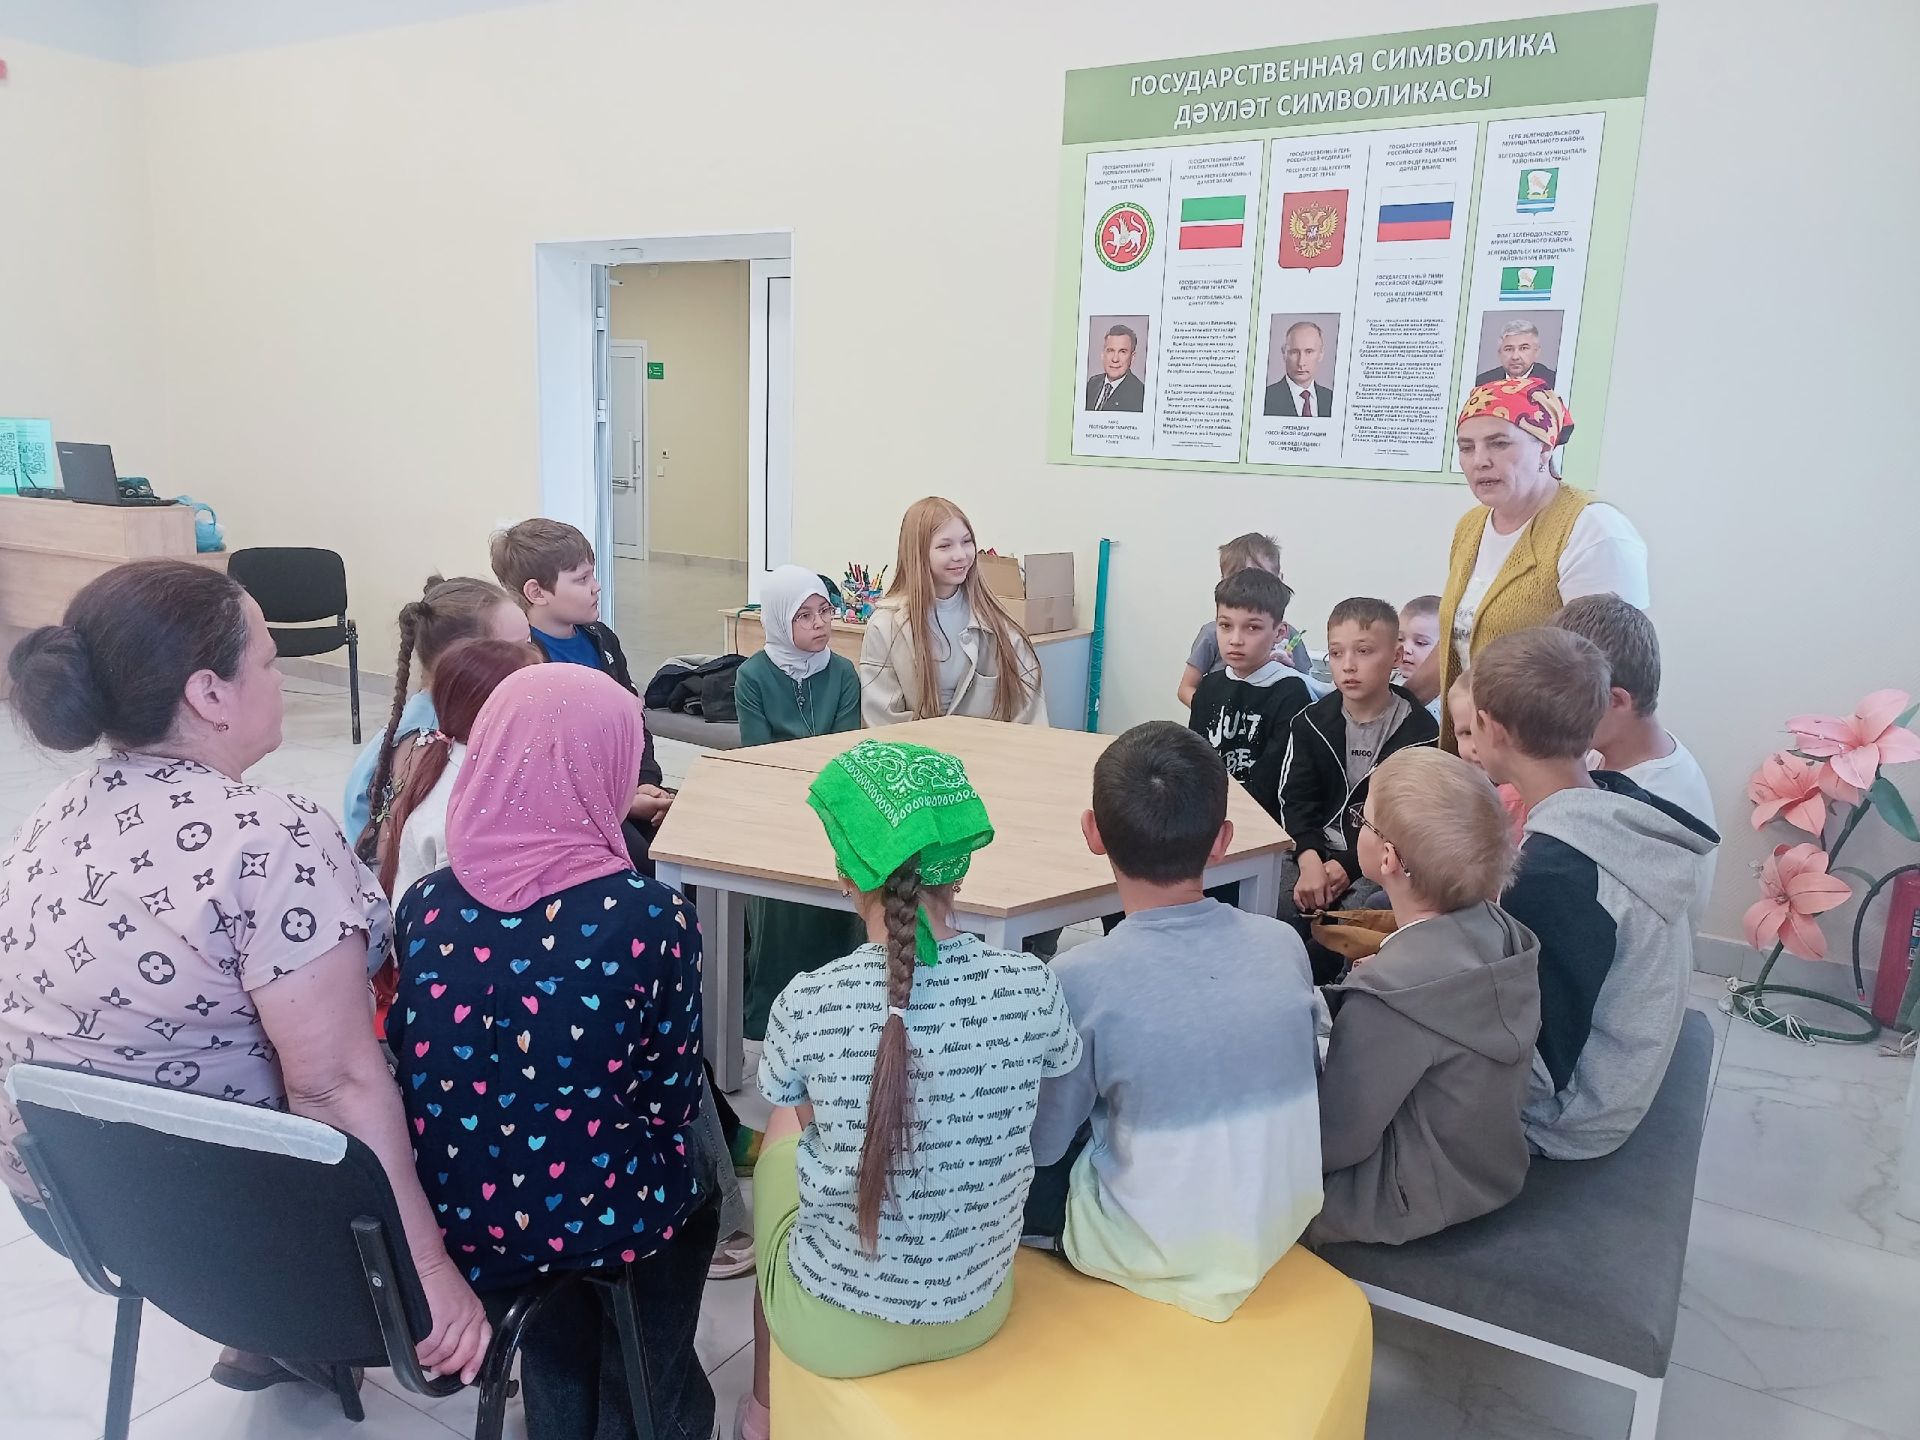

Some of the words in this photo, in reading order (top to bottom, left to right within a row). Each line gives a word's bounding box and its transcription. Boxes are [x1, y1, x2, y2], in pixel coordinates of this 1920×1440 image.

[1130, 53, 1364, 97] ГОСУДАРСТВЕННАЯ
[1371, 31, 1556, 71] СИМВОЛИКА
[1174, 97, 1270, 129] ДӘҮЛӘТ
[1276, 75, 1492, 116] СИМВОЛИКАСЫ
[1221, 748, 1256, 774] BE
[1351, 749, 1372, 758] HUGO
[946, 954, 970, 966] Tokyo
[836, 979, 862, 989] Tokyo
[924, 976, 950, 988] Paris
[962, 968, 990, 982] Milan
[815, 1002, 842, 1016] Milan
[855, 1002, 882, 1014] Paris
[950, 995, 978, 1008] Tokyo
[991, 987, 1016, 1001] Milan
[818, 1025, 855, 1038] Moscow
[912, 1022, 946, 1036] Milan
[960, 1016, 988, 1031] Tokyo
[802, 1052, 826, 1066] Paris
[838, 1047, 879, 1060] Moscow
[938, 1042, 972, 1055] Milan
[986, 1034, 1012, 1048] Paris
[817, 1072, 838, 1084] Paris
[946, 1064, 988, 1077] Moscow
[1001, 1057, 1024, 1069] Paris
[832, 1098, 862, 1110] Tokyo
[928, 1094, 956, 1106] Paris
[970, 1086, 1009, 1100] Moscow
[947, 1111, 974, 1125] Paris
[986, 1106, 1015, 1120] Milan
[913, 1140, 954, 1154] Moscow
[966, 1136, 994, 1147] Tokyo
[938, 1158, 966, 1172] Paris
[978, 1154, 1006, 1168] Milan
[818, 1184, 850, 1196] Milan
[906, 1188, 947, 1202] Moscow
[958, 1182, 985, 1192] Tokyo
[918, 1208, 951, 1222] Milan
[964, 1202, 990, 1214] Tokyo
[896, 1233, 926, 1246] Tokyo
[940, 1226, 970, 1243] Milan
[902, 1252, 933, 1267] Tokyo
[945, 1243, 979, 1263] Moscow
[802, 1262, 827, 1283] Milan
[842, 1282, 870, 1298] Tokyo
[883, 1296, 928, 1310] Moscow
[942, 1292, 968, 1306] Paris
[831, 1263, 860, 1278] Tokyo
[874, 1272, 910, 1285] Milan
[924, 1276, 952, 1288] Paris
